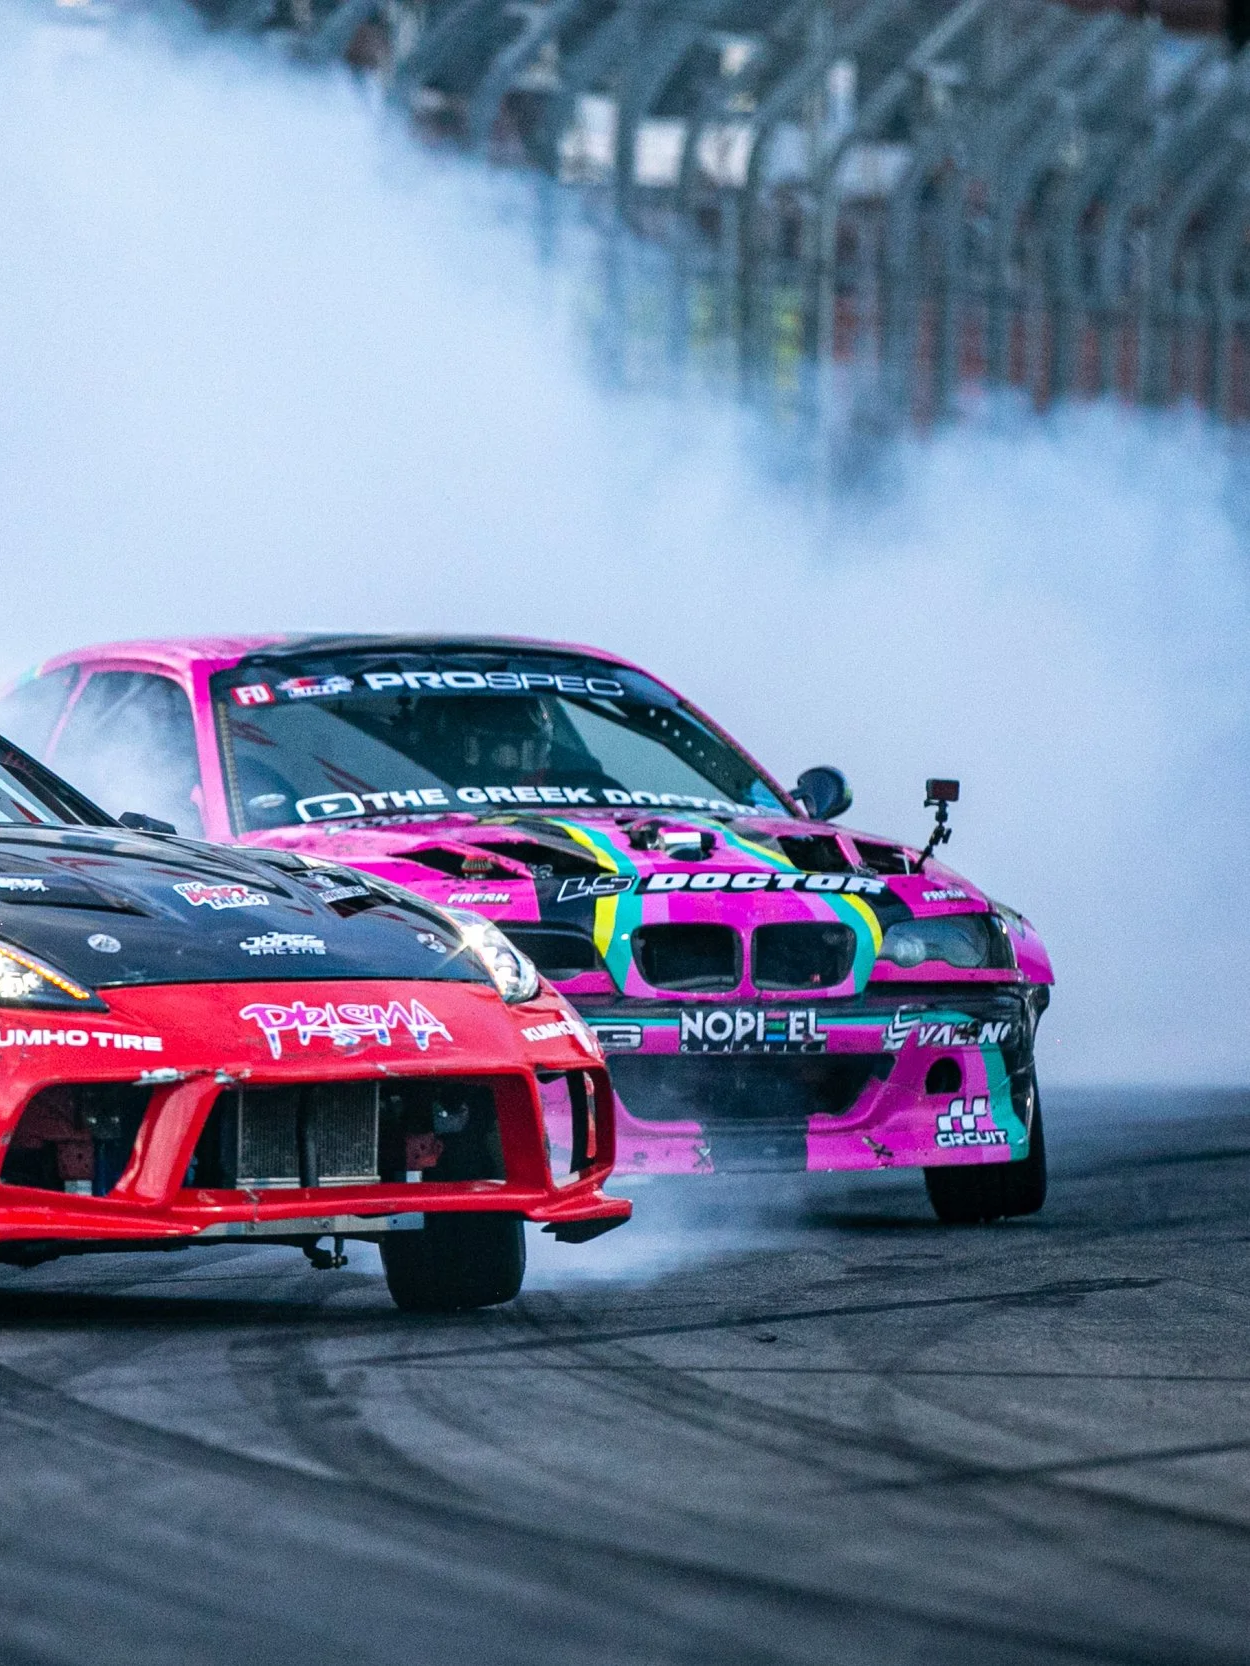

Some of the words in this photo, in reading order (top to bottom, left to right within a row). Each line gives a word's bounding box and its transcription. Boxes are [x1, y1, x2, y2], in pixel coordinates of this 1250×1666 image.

[235, 685, 270, 704] FD
[363, 672, 624, 696] PROSPEC
[362, 788, 449, 810] THE
[457, 787, 596, 803] GREEK
[646, 873, 885, 894] DOCTOR
[239, 999, 453, 1060] PRISMA
[918, 1022, 1012, 1046] VALN
[96, 1032, 163, 1051] TIRE
[936, 1131, 1007, 1147] CIRCUIT
